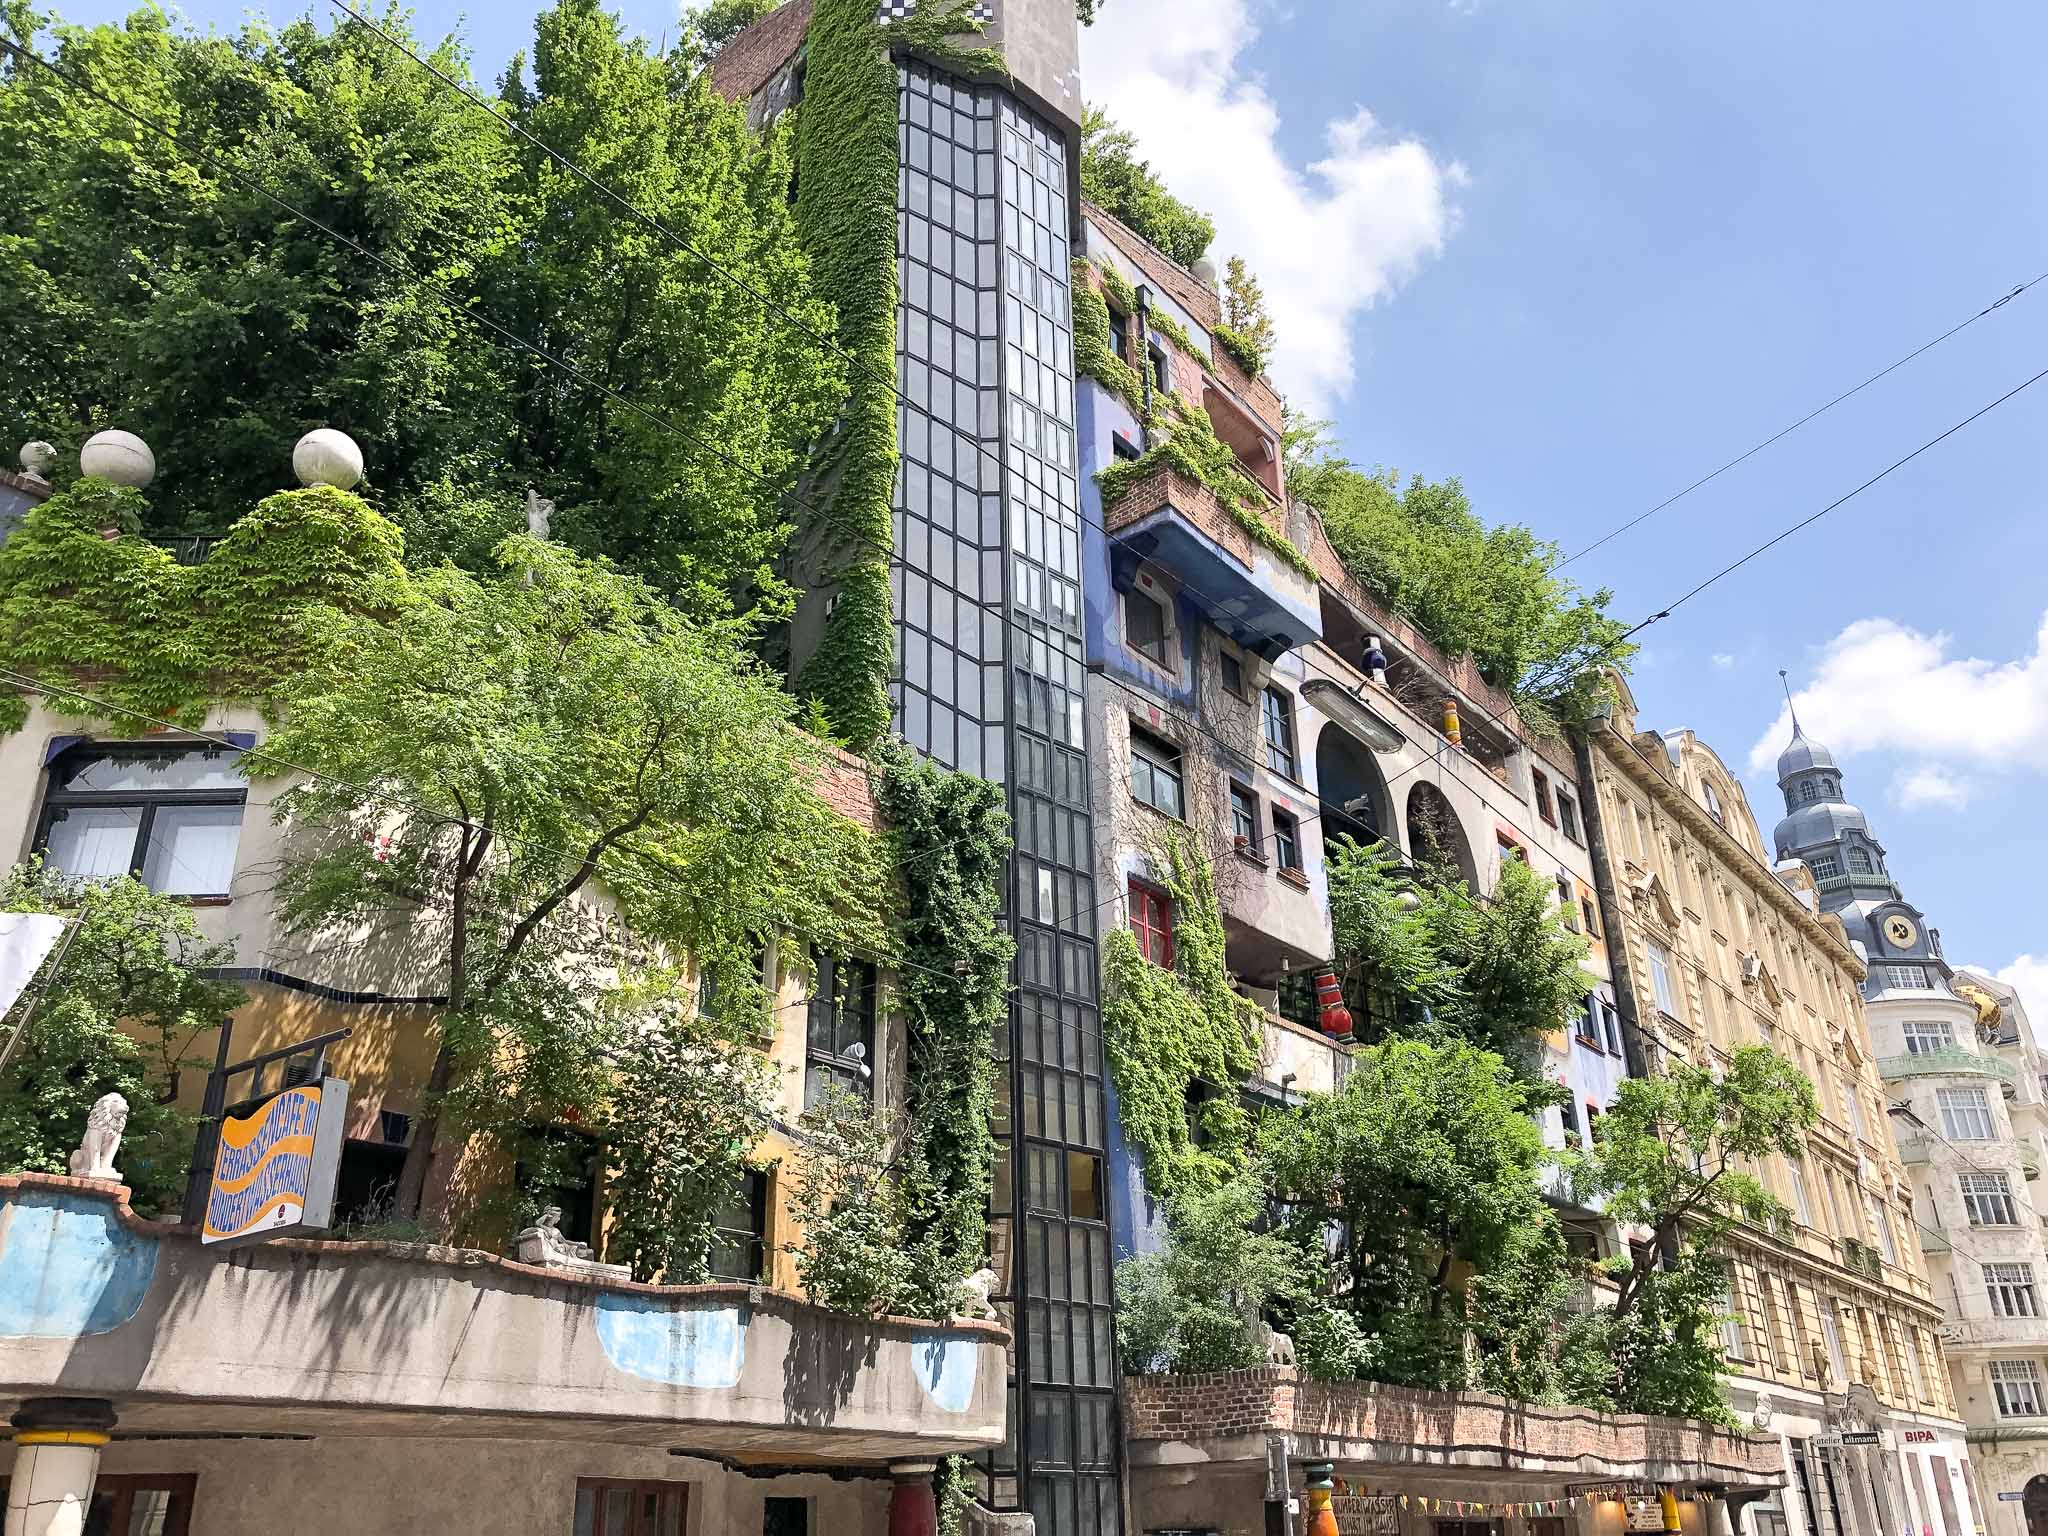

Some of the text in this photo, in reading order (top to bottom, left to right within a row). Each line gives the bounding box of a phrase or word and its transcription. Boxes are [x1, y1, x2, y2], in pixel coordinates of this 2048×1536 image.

[302, 1097, 319, 1135] IM
[208, 1152, 308, 1232] HUNDERTWASSERHAUS
[1816, 1435, 1878, 1446] atelier altmann
[1905, 1430, 1935, 1442] BIPA
